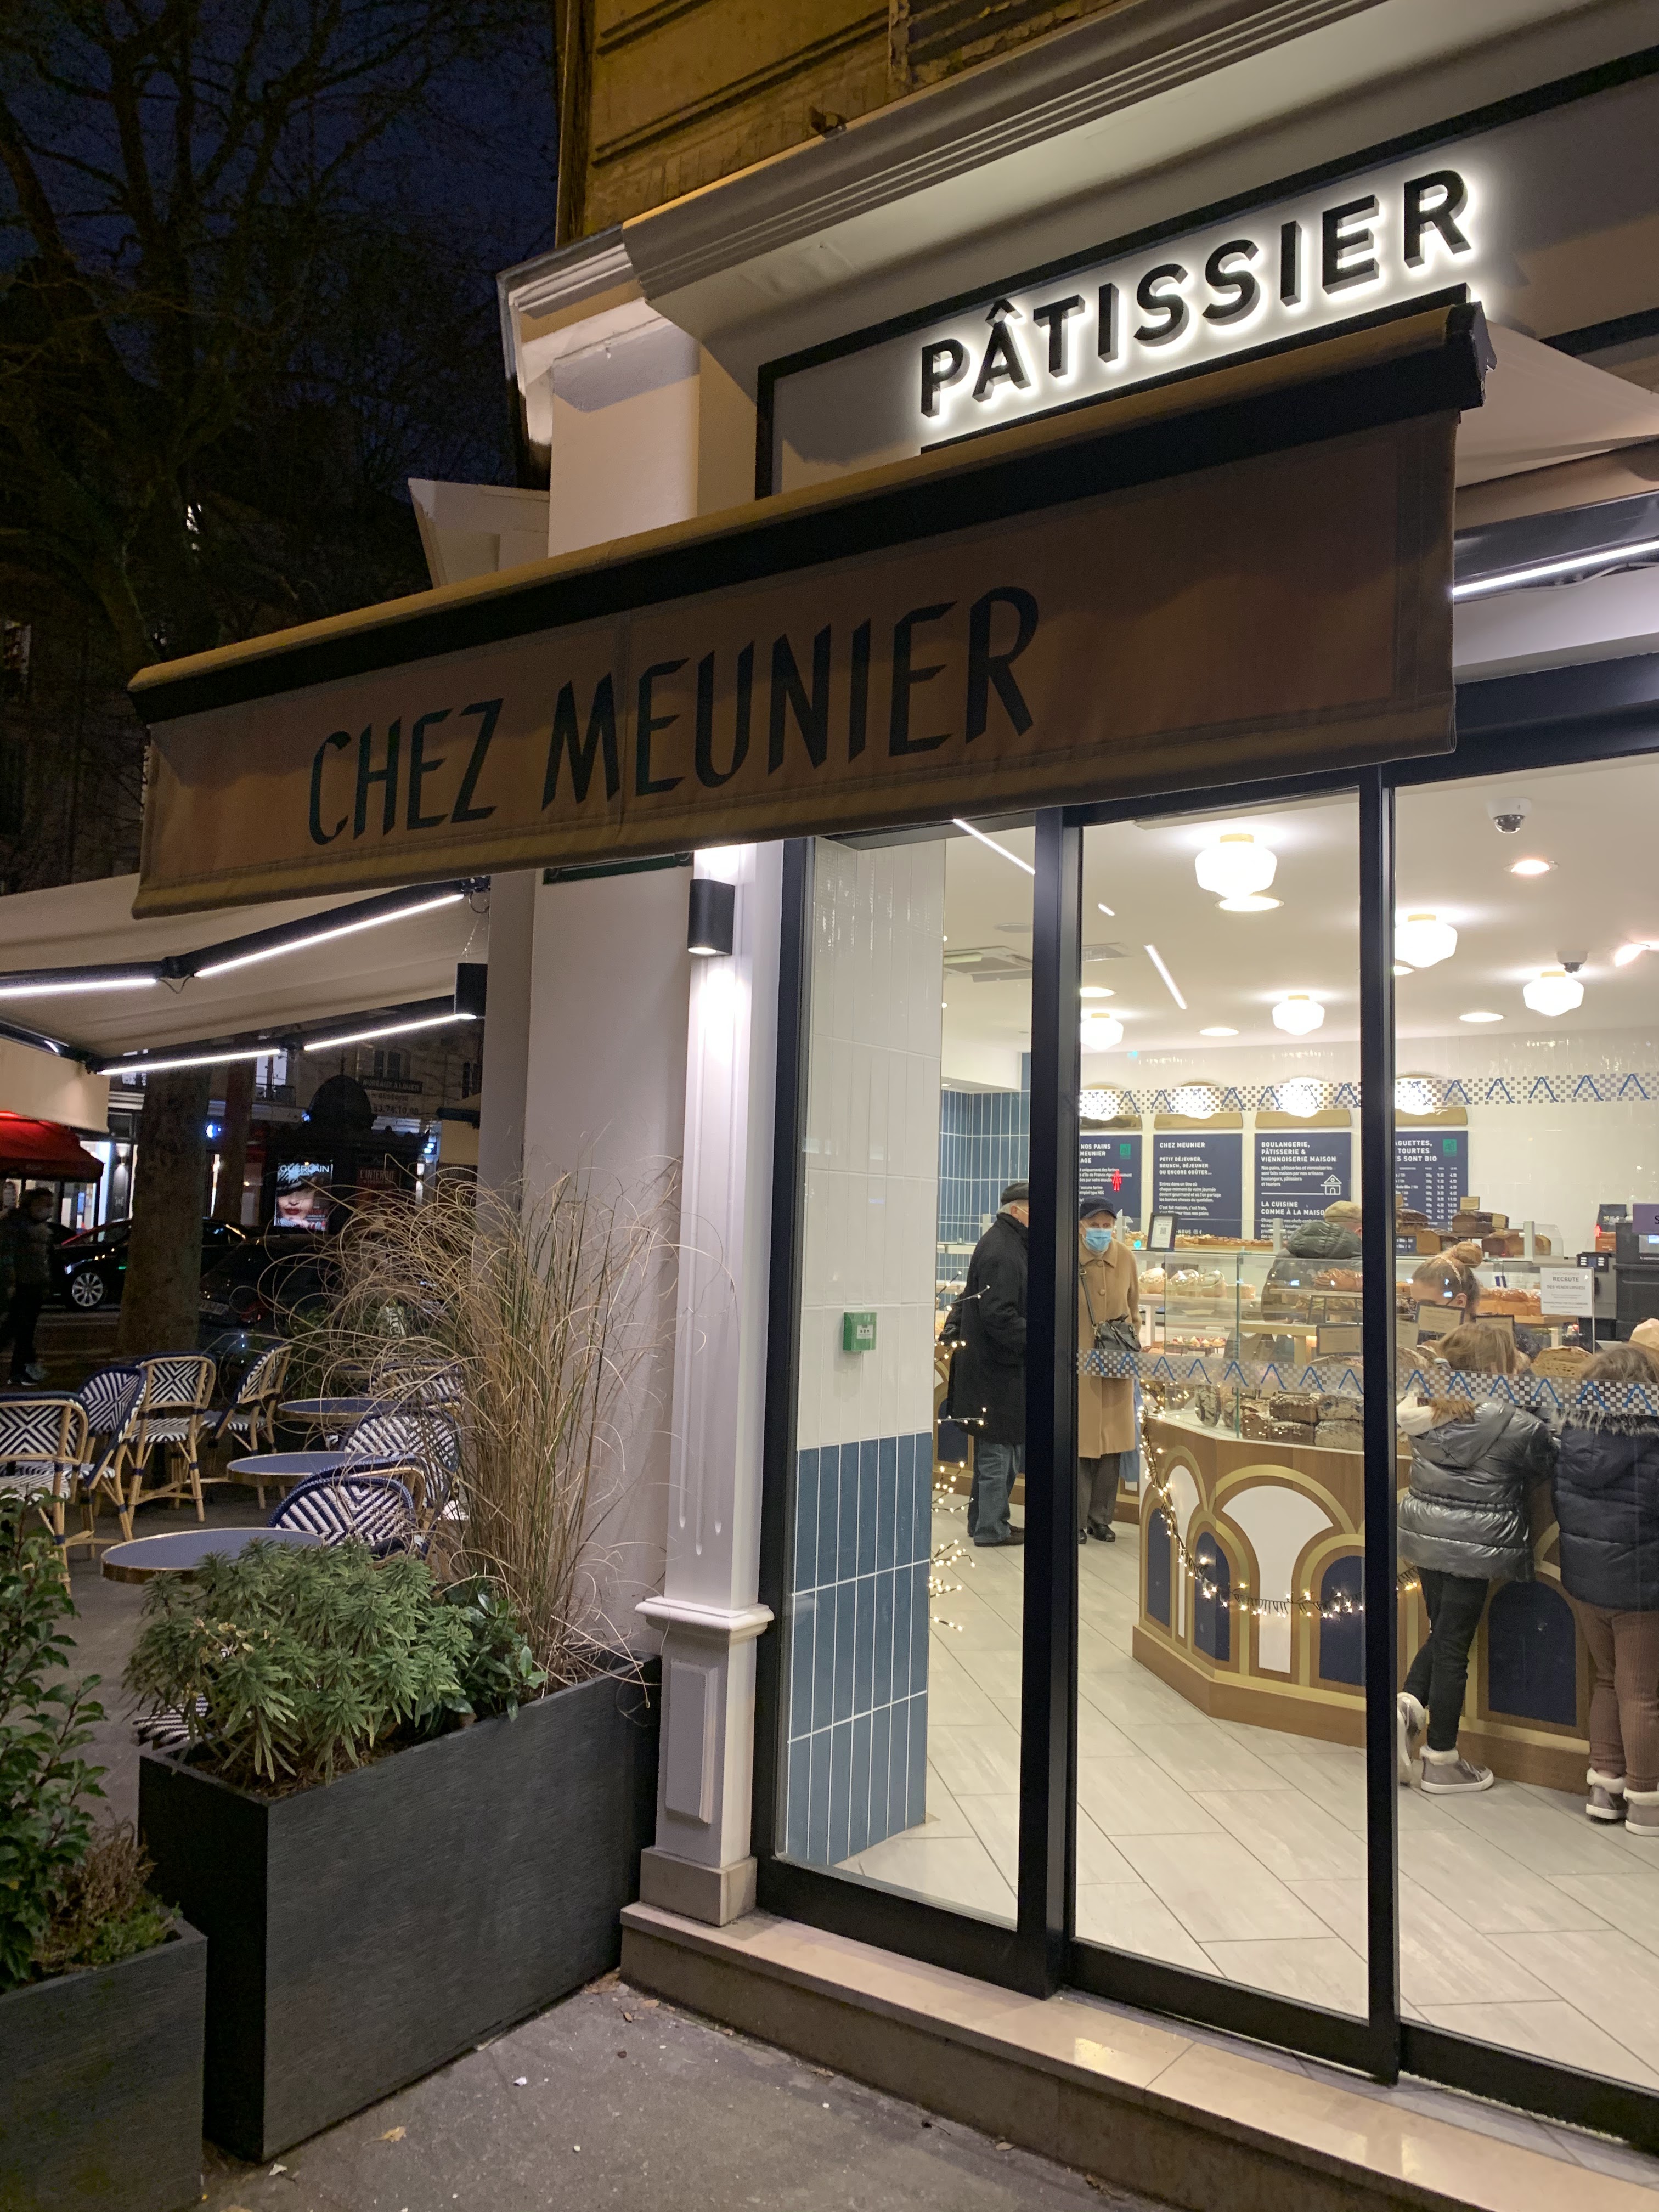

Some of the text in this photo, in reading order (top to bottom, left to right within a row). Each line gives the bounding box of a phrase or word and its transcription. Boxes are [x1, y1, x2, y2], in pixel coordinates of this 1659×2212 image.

[921, 169, 1472, 418] PÂTISSIER
[308, 585, 1039, 846] CHEZ MEUNIER
[280, 1164, 329, 1173] GUERLAIN
